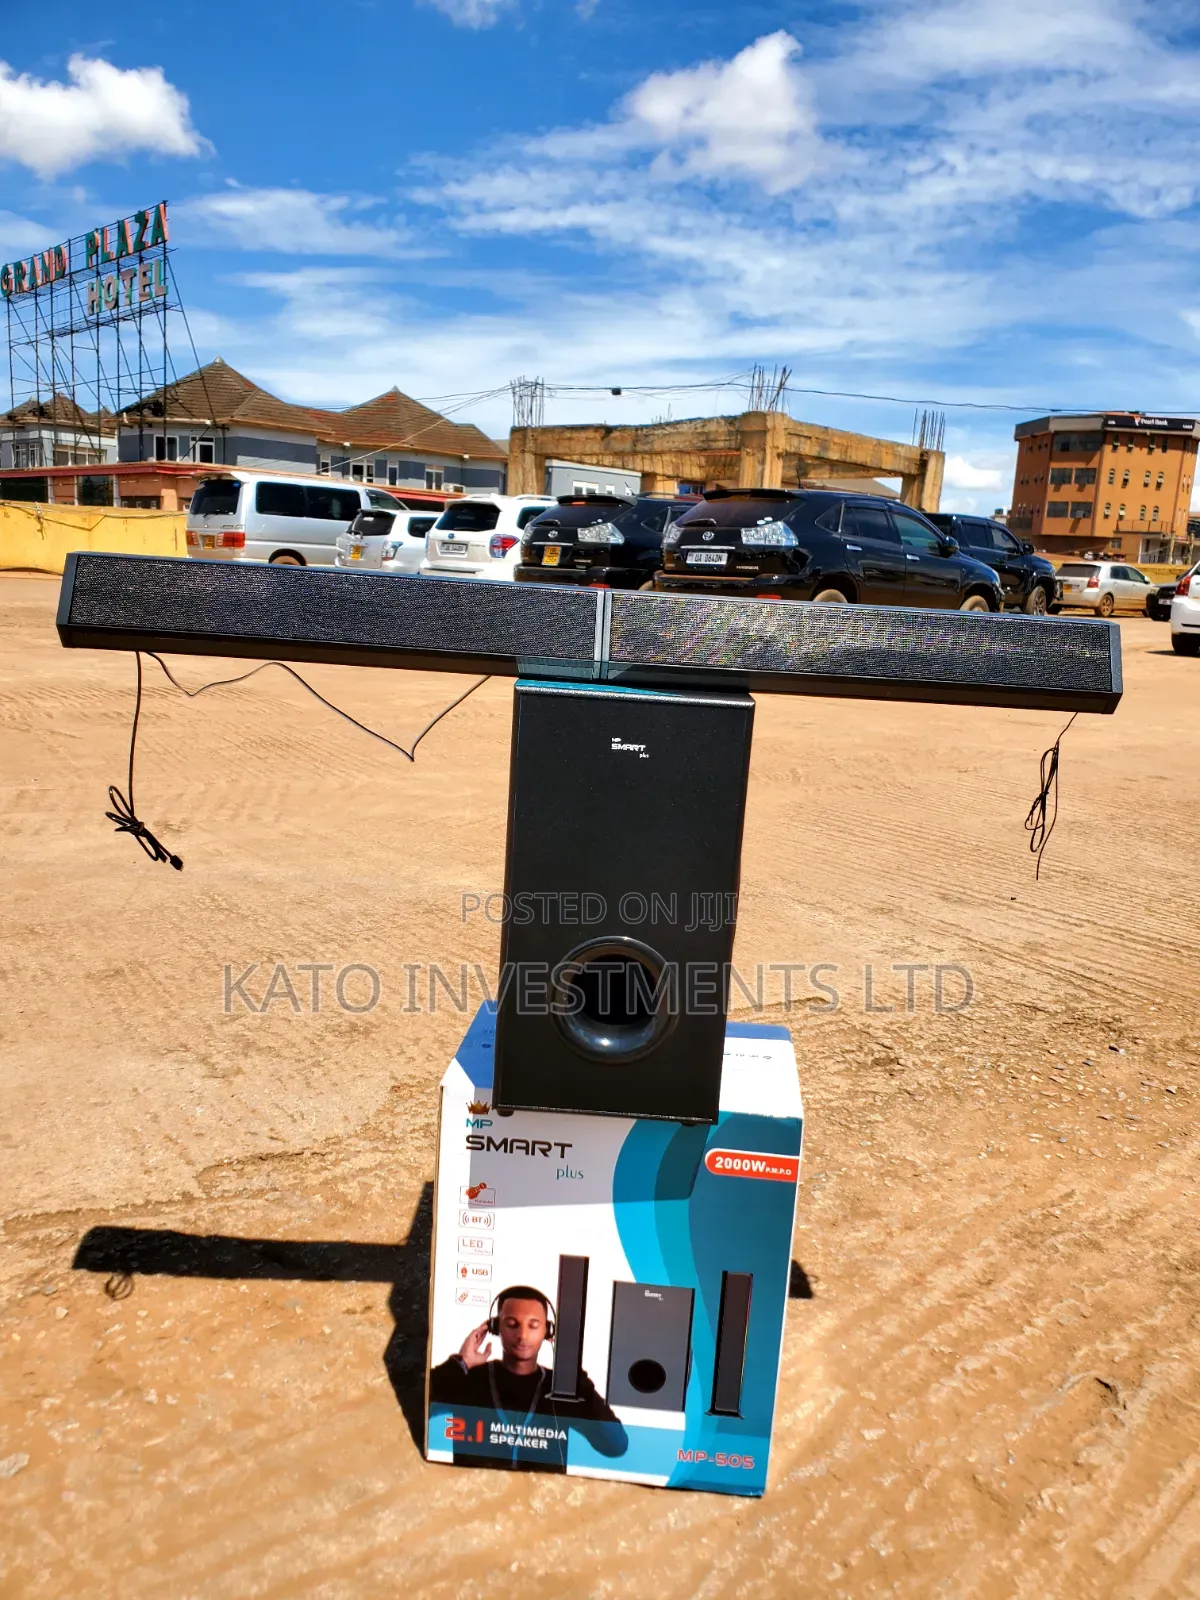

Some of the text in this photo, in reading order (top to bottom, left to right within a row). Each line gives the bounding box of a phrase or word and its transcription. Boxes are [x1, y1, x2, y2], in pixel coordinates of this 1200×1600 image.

[0, 203, 169, 297] GRAND PLAZA
[87, 258, 168, 316] HOTEL
[611, 743, 646, 751] SMART
[466, 1118, 493, 1129] MP
[466, 1134, 573, 1159] SMART
[556, 1164, 584, 1180] plus
[714, 1156, 766, 1173] 2000W
[471, 1216, 482, 1224] BT
[462, 1238, 483, 1249] LED
[471, 1268, 489, 1276] USB
[444, 1417, 484, 1443] 2.1
[490, 1421, 567, 1441] MULTIMEDIA
[489, 1433, 548, 1450] SPEAKER
[677, 1448, 755, 1470] MP-505
